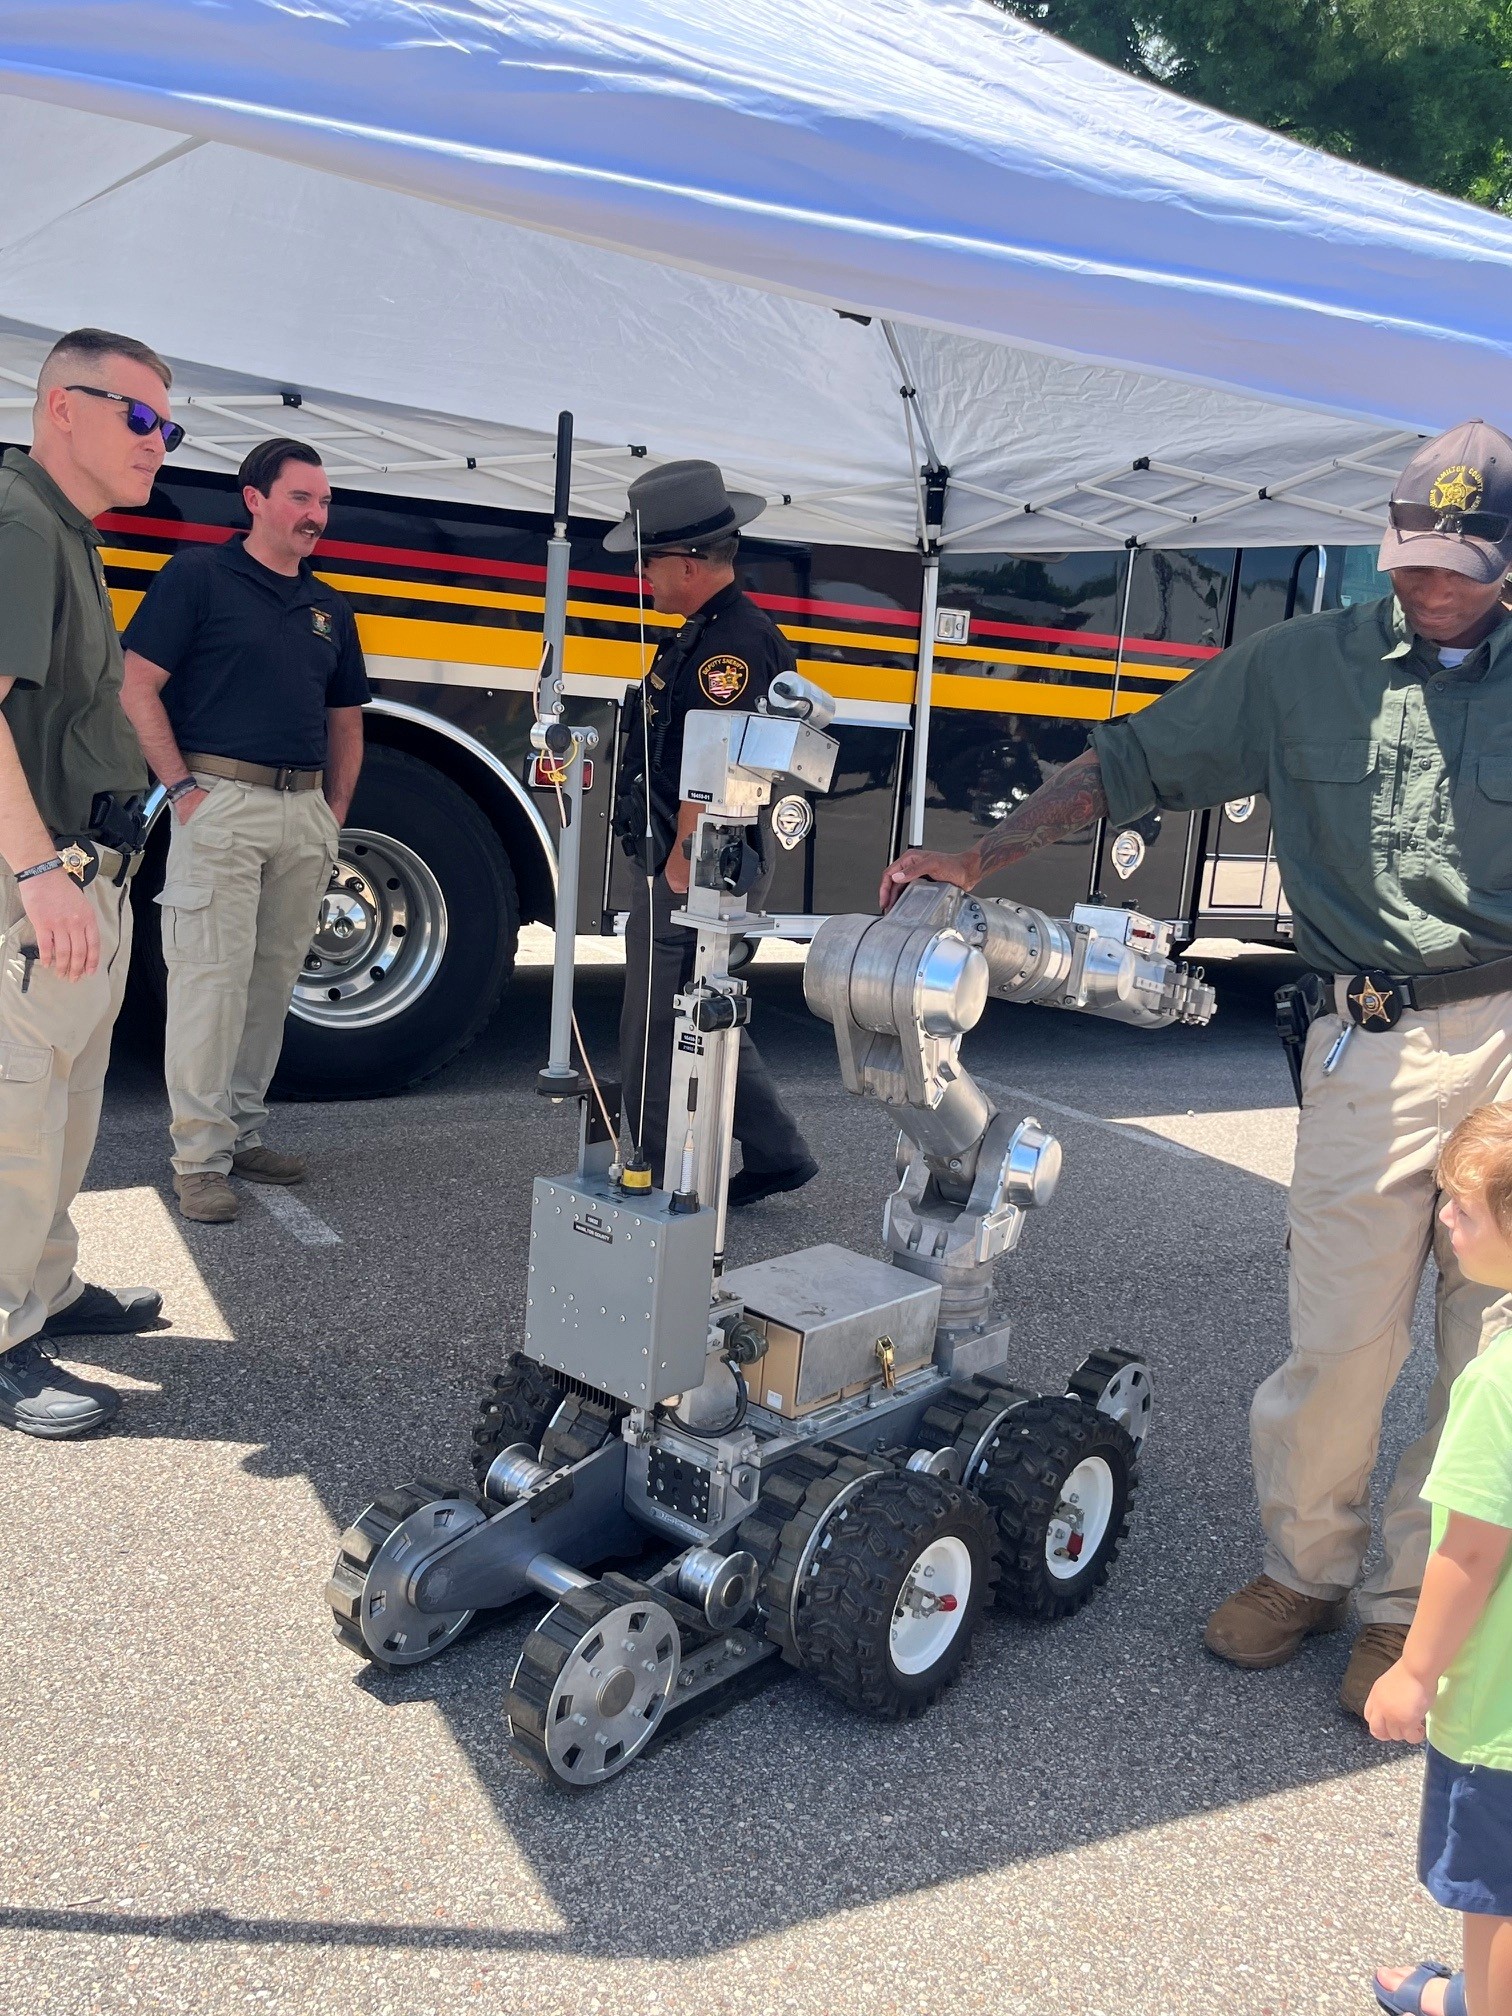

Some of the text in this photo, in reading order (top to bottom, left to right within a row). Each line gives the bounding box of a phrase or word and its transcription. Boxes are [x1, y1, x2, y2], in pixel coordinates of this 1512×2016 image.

[1434, 465, 1484, 492] HAMILTON COUNTY
[702, 658, 745, 675] DEPUTY SHERIFF
